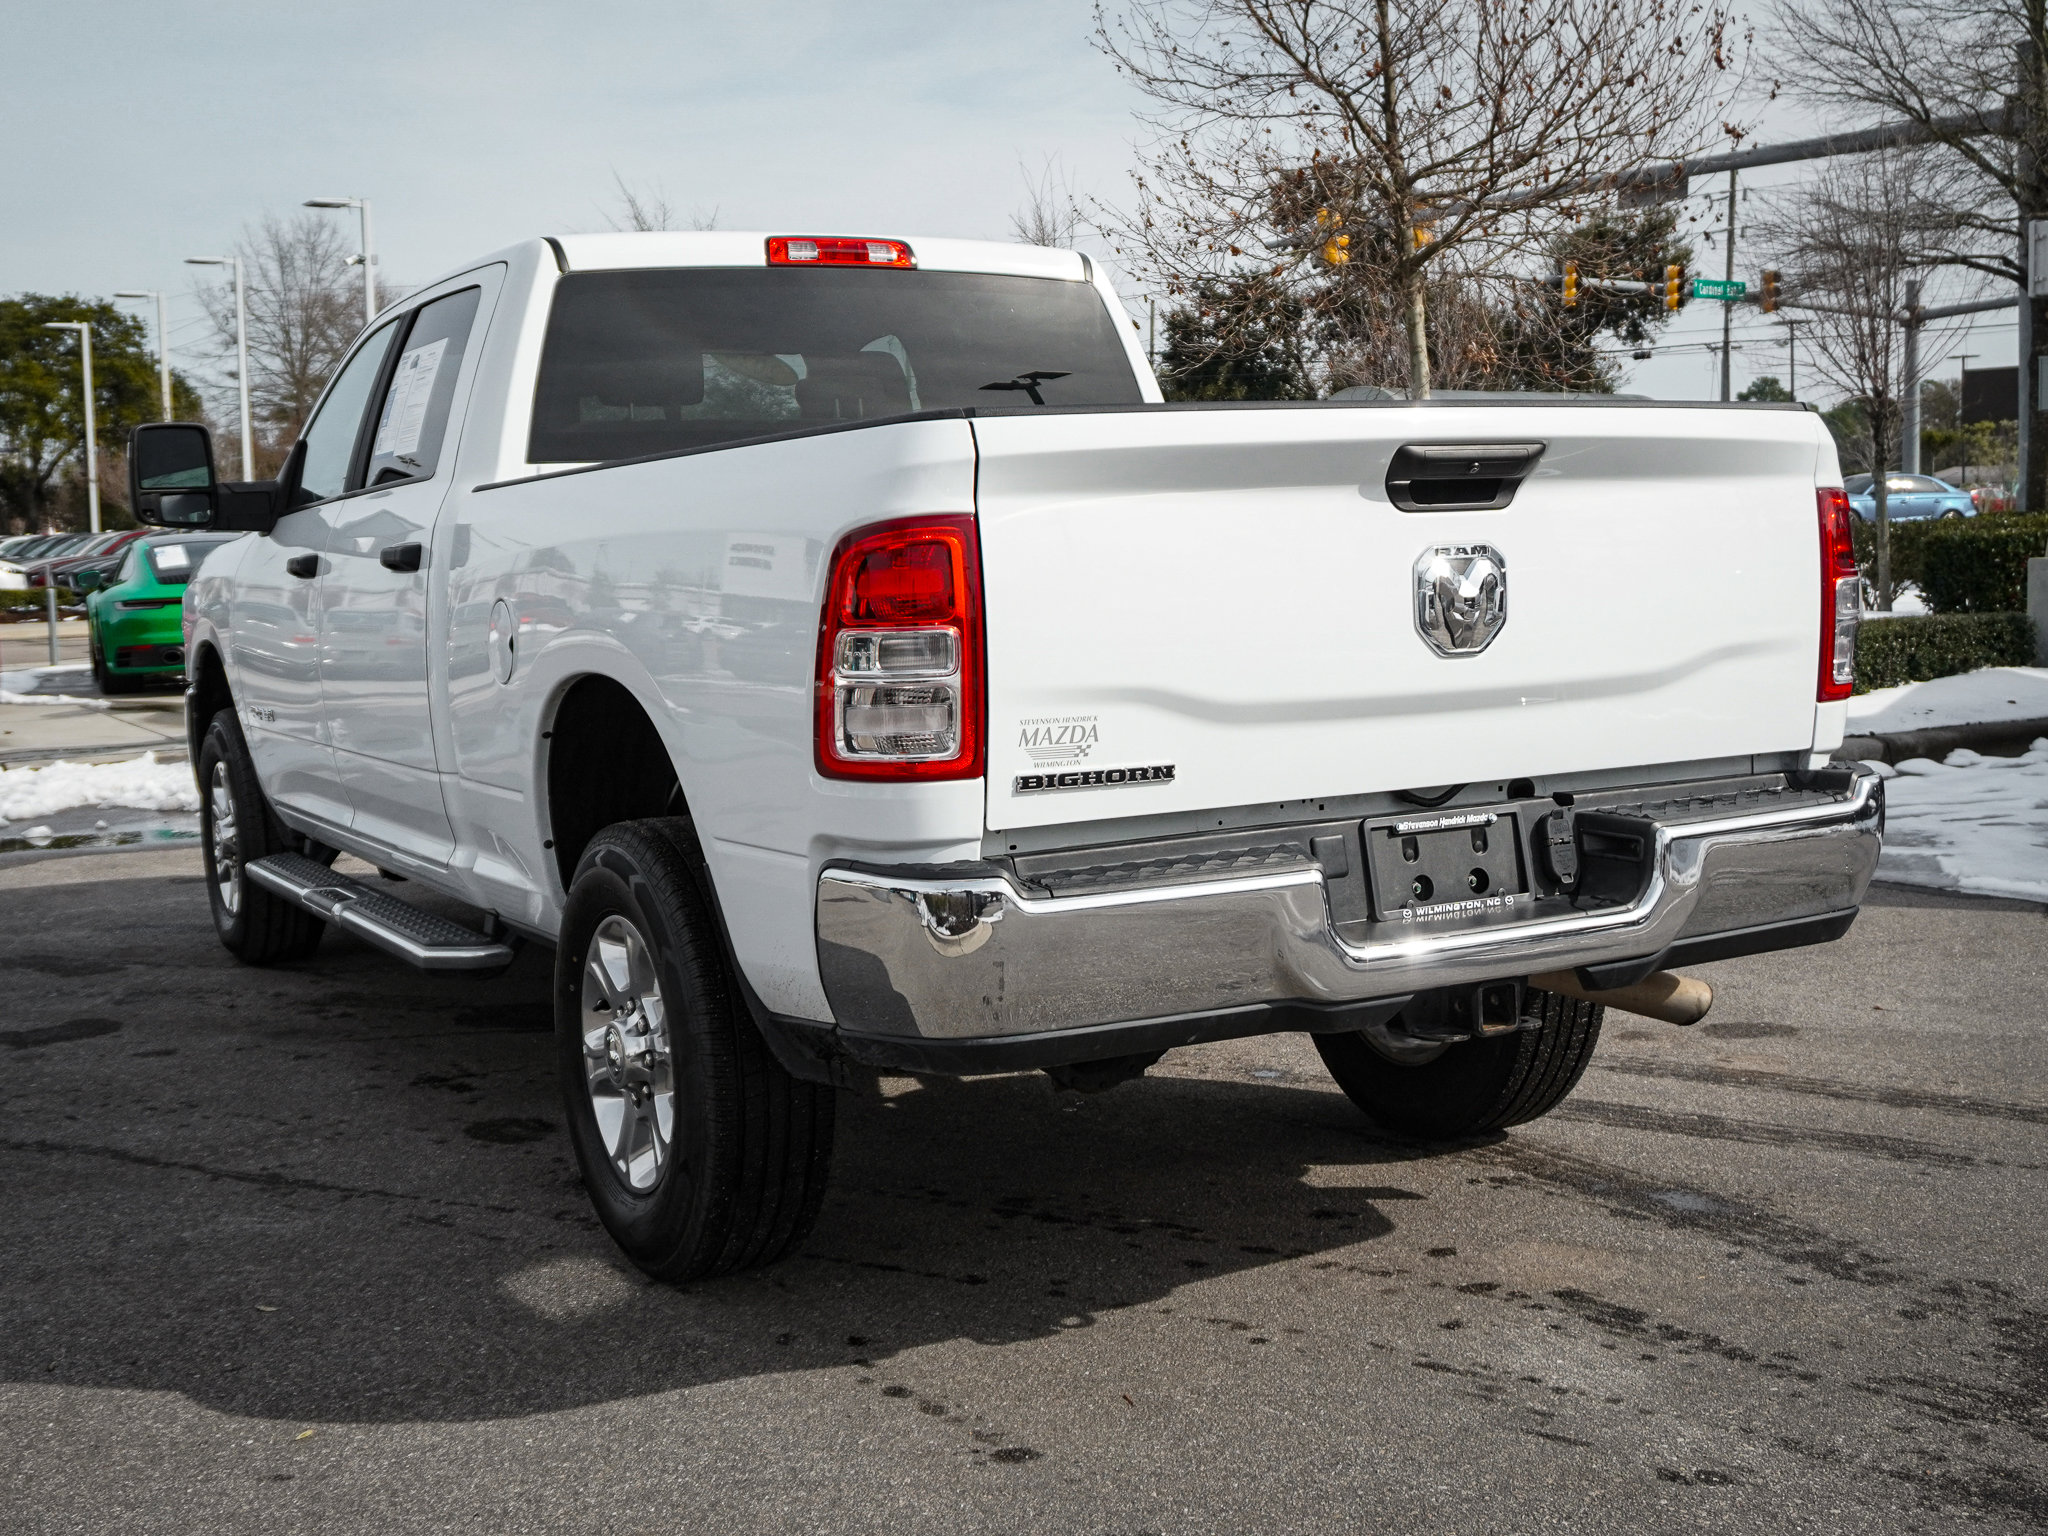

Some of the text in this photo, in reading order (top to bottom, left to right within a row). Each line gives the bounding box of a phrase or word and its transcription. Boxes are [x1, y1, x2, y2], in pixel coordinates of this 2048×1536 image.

[1699, 282, 1724, 295] Cardinal
[1434, 545, 1488, 556] RAM
[1019, 715, 1099, 726] STEVENSON HENDRICK
[1018, 723, 1099, 748] MAZDA
[1033, 759, 1082, 769] WILMINGTON
[1015, 764, 1176, 793] BIGHORN
[1403, 819, 1438, 830] Stevenson
[1466, 812, 1488, 824] Mazda
[1486, 897, 1501, 906] NC
